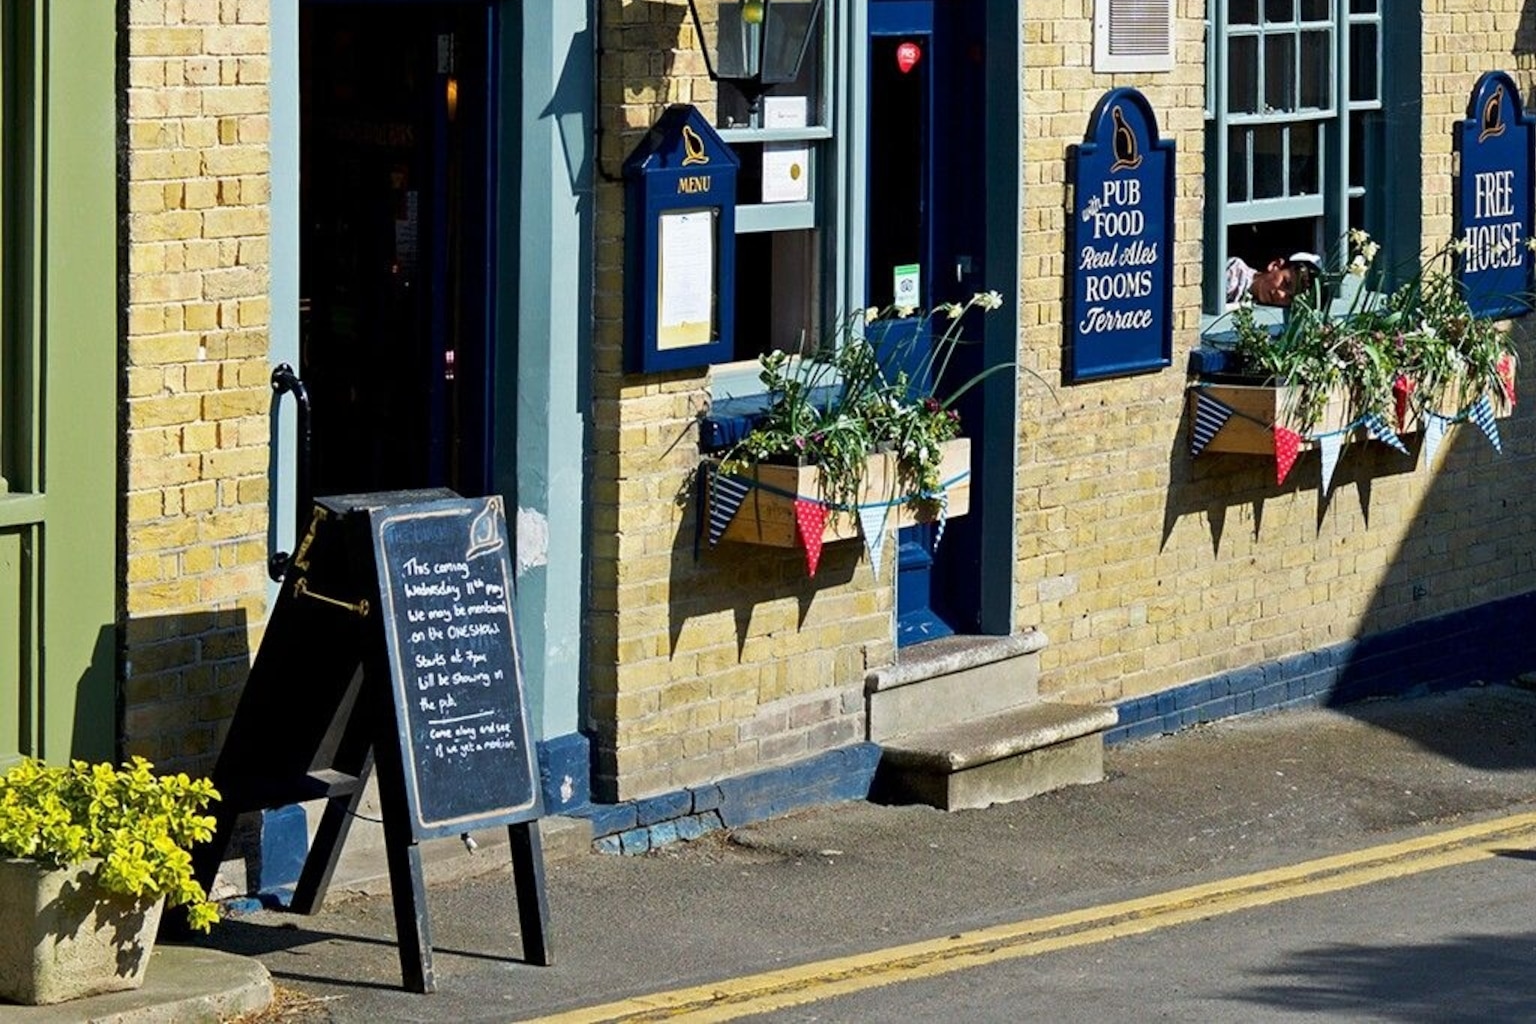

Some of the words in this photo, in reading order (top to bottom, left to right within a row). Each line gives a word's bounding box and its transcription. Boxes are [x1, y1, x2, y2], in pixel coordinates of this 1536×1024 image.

[677, 176, 711, 193] MENU
[1103, 179, 1141, 208] PUB
[1475, 170, 1515, 218] FREE
[1093, 210, 1144, 239] FOOD
[1079, 242, 1118, 271] Real
[1119, 241, 1157, 265] Ales
[1464, 222, 1523, 274] HOUSE
[1085, 270, 1152, 302] ROOMS
[1079, 307, 1153, 335] Terrace
[403, 557, 431, 576] This
[433, 562, 471, 579] coming
[404, 580, 462, 602] Wednesday
[428, 608, 453, 623] may
[453, 603, 467, 618] be
[411, 631, 426, 644] on
[428, 626, 444, 642] the
[415, 653, 447, 668] Starts
[450, 648, 464, 664] at
[465, 650, 488, 668] 7pm
[418, 672, 436, 691] Will
[438, 673, 450, 687] be
[419, 696, 437, 712] the
[455, 724, 477, 740] along
[479, 722, 496, 734] and
[446, 744, 459, 755] we
[459, 740, 475, 758] get
